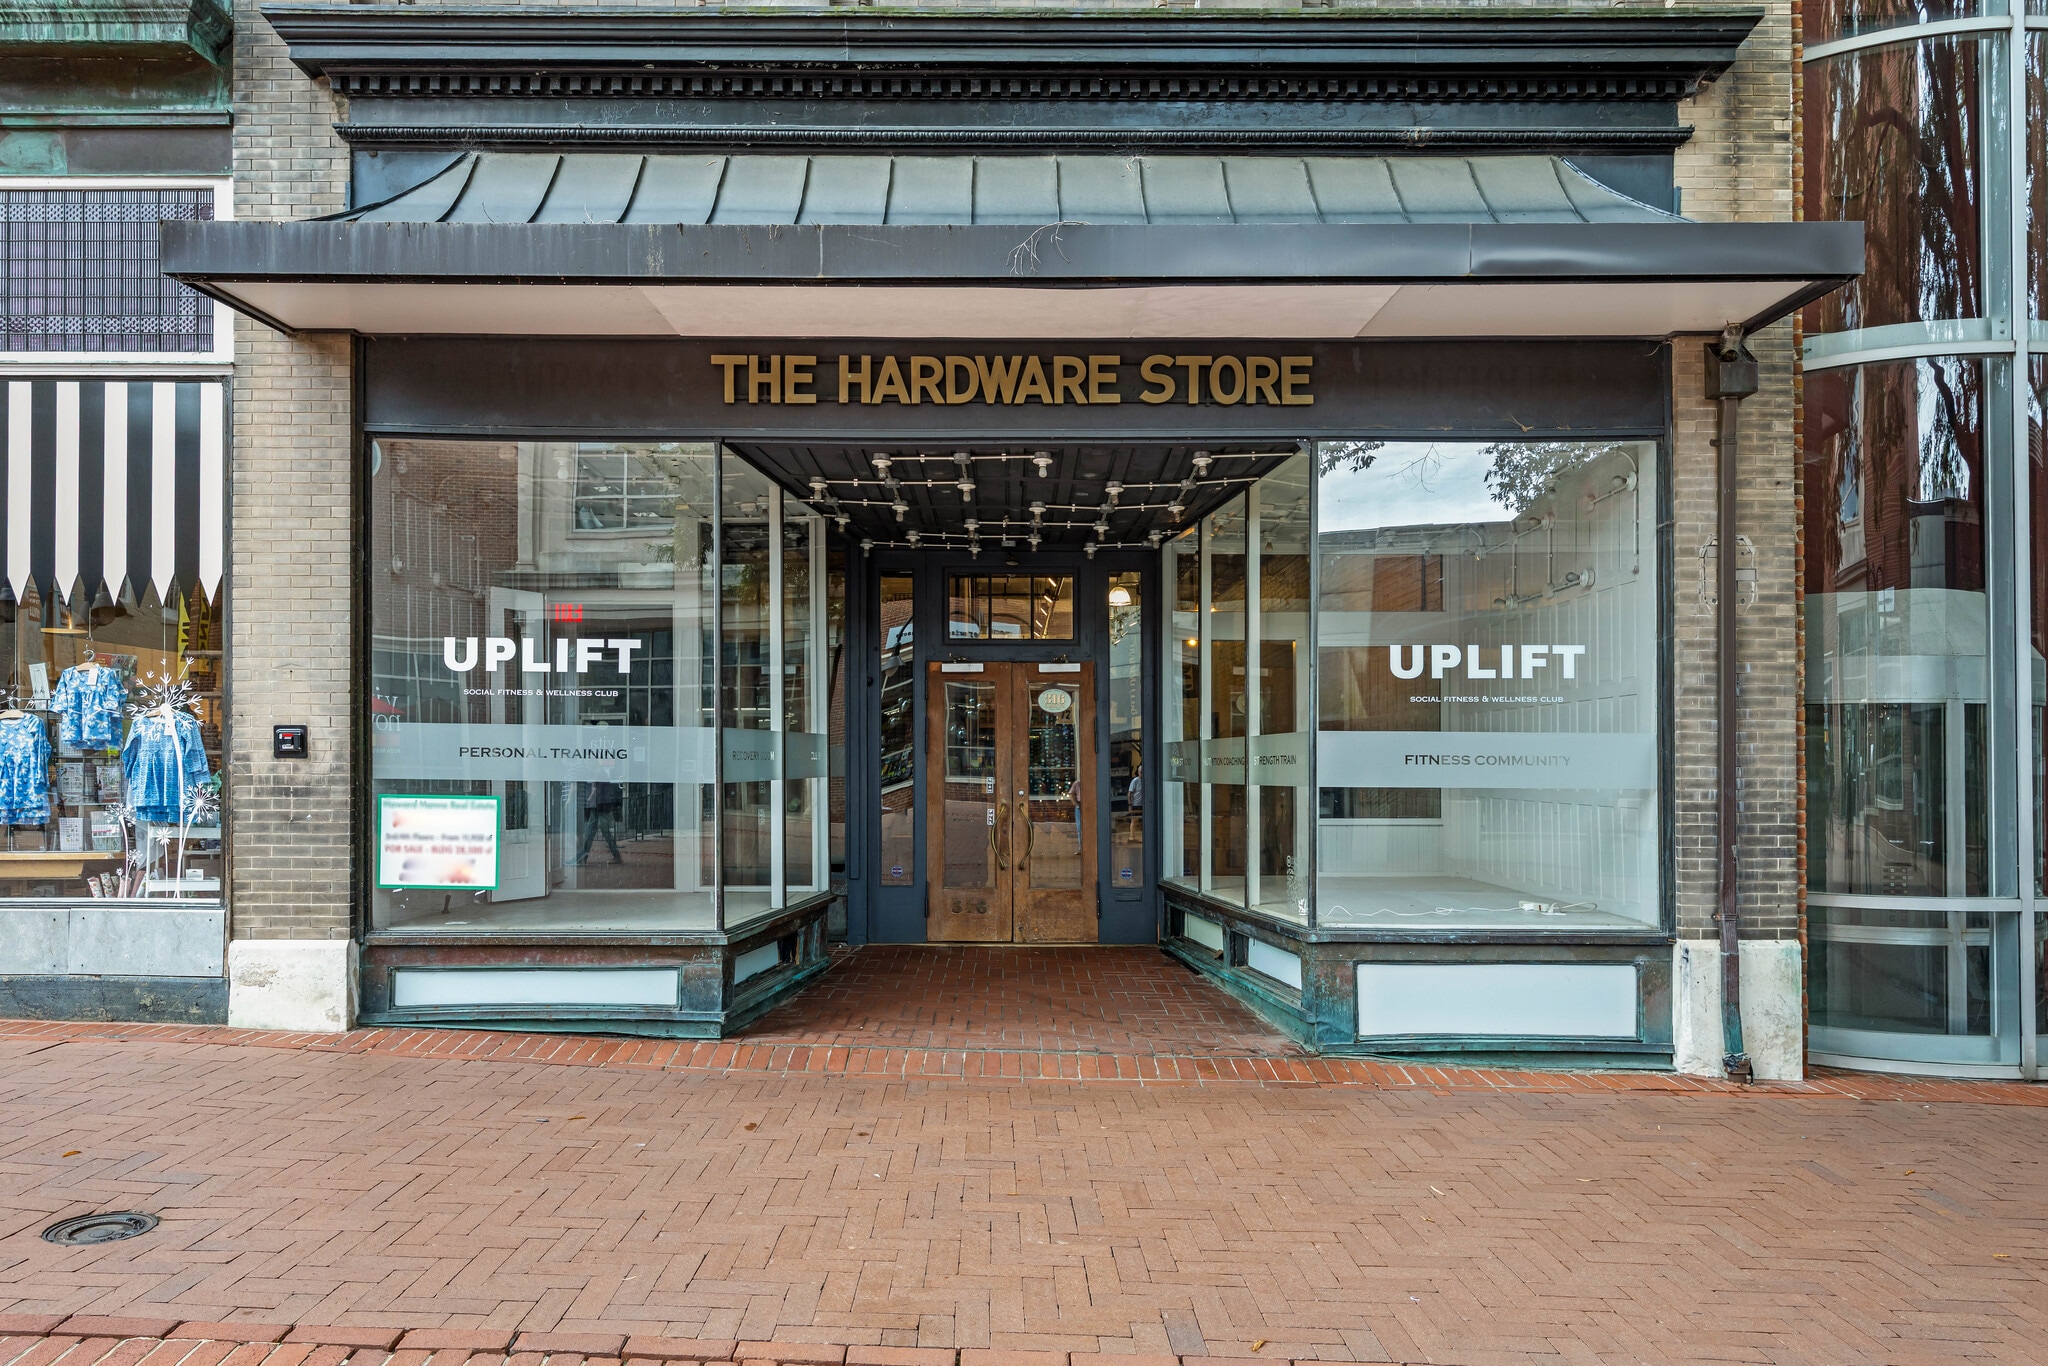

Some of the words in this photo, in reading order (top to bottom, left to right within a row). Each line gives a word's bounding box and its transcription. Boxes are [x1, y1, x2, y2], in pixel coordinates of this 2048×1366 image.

[710, 354, 817, 404] THE
[838, 354, 1121, 404] HARDWARE
[1139, 354, 1314, 404] STORE
[443, 636, 642, 674] UPLIFT
[1389, 644, 1586, 680] UPLIFT
[463, 688, 495, 696] SOCIAL
[545, 689, 593, 697] WELLNESS
[1044, 693, 1065, 705] 316
[1481, 695, 1489, 703] &
[459, 746, 547, 759] PERSONAL
[550, 747, 628, 760] TRAINING
[732, 750, 760, 761] RECOVERY
[1223, 756, 1245, 766] COACHING
[1253, 754, 1279, 766] STRENGTH
[1404, 754, 1471, 765] FITNESS
[1474, 755, 1571, 766] COMMUNITY
[951, 898, 988, 915] 316
